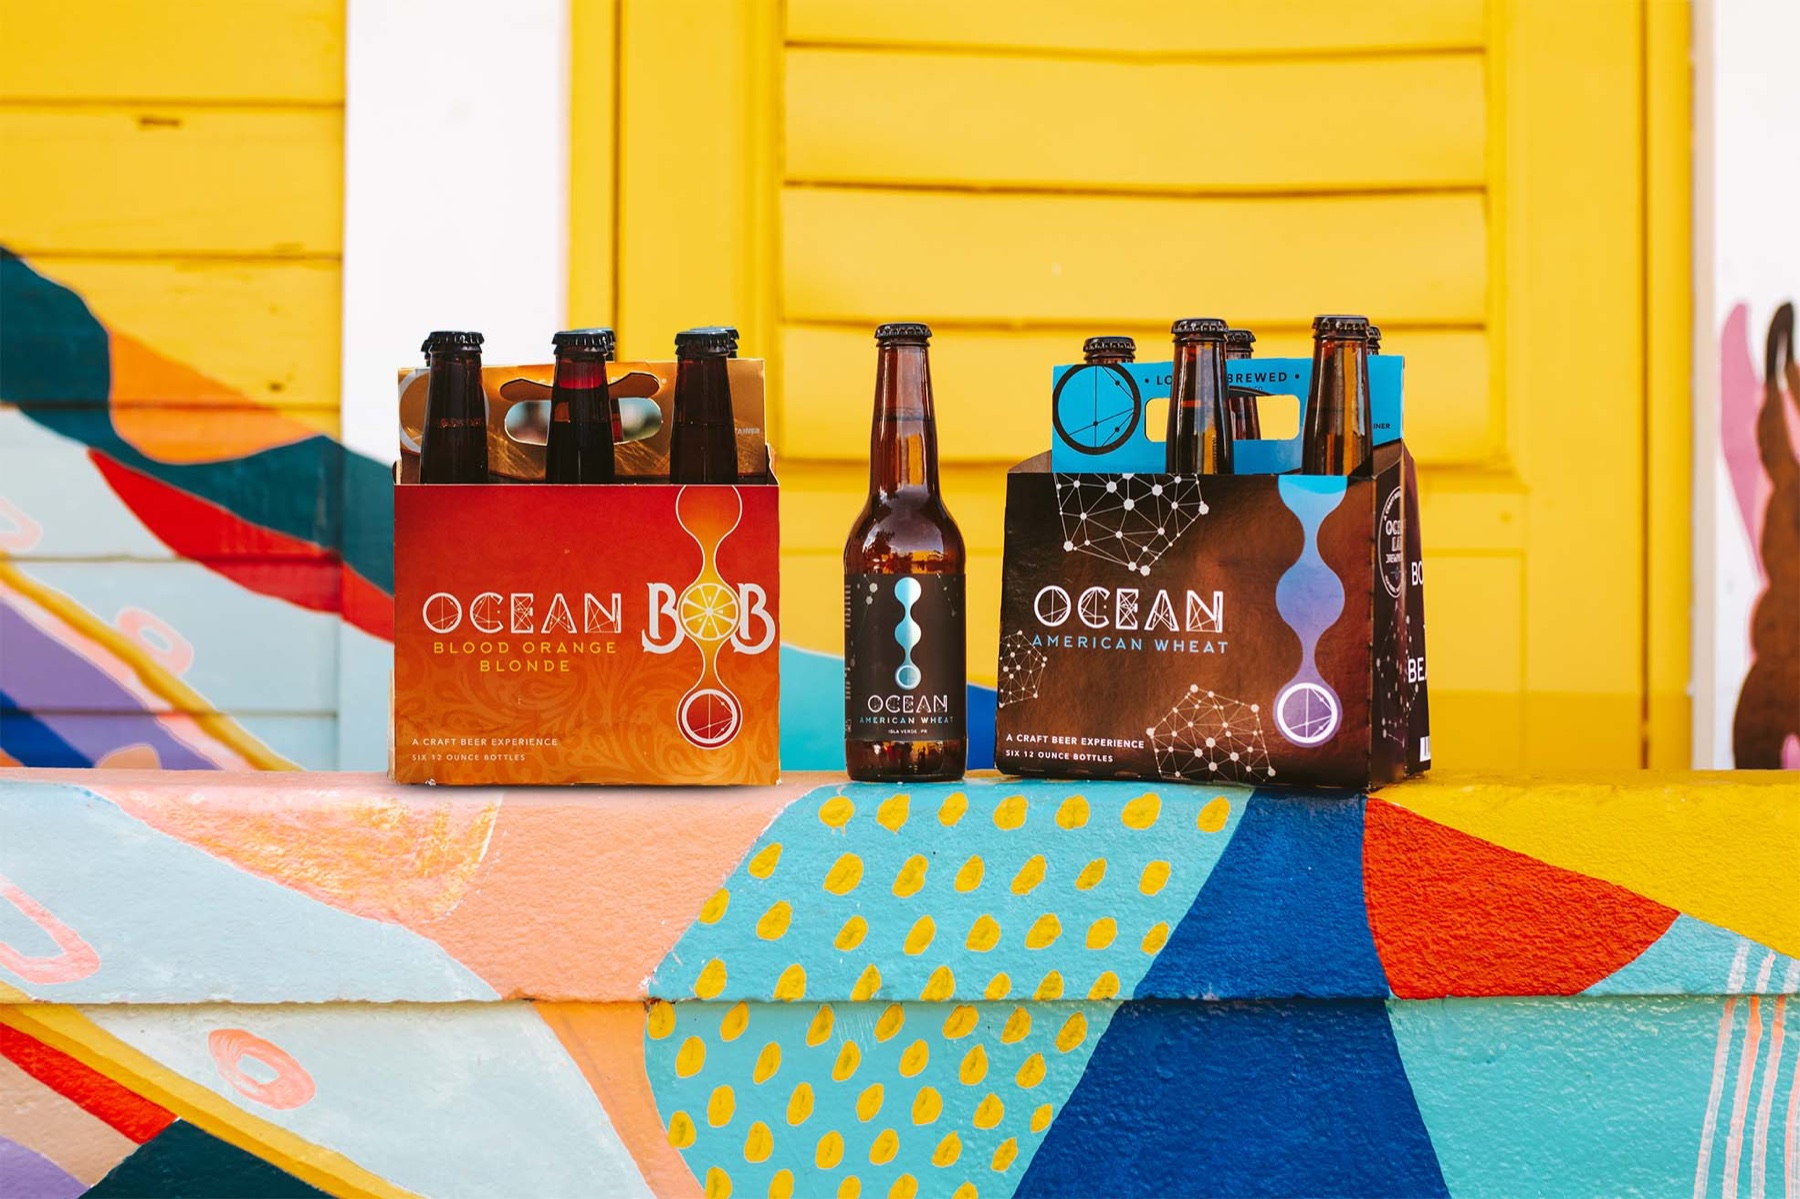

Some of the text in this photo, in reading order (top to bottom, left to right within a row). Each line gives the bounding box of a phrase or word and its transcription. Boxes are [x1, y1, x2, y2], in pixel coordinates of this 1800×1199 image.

[422, 591, 622, 635] OCEAN
[1033, 585, 1225, 634] OCEAN
[433, 641, 617, 655] BLOOD ORANGE
[1031, 634, 1230, 655] AMERICAN WHEAT
[479, 659, 571, 673] BLONDE
[867, 694, 948, 714] OCEAN
[859, 716, 954, 725] AMERICAN WHEAT
[411, 738, 558, 746] A CRAFT BEER EXPERIENCE
[1006, 733, 1145, 749] A CRAFT BEER EXPERIENCE
[411, 753, 526, 761] SIX 12 OUNCE BOTTLES
[1005, 749, 1114, 763] SIX 12 OUNCE BOTTLES
